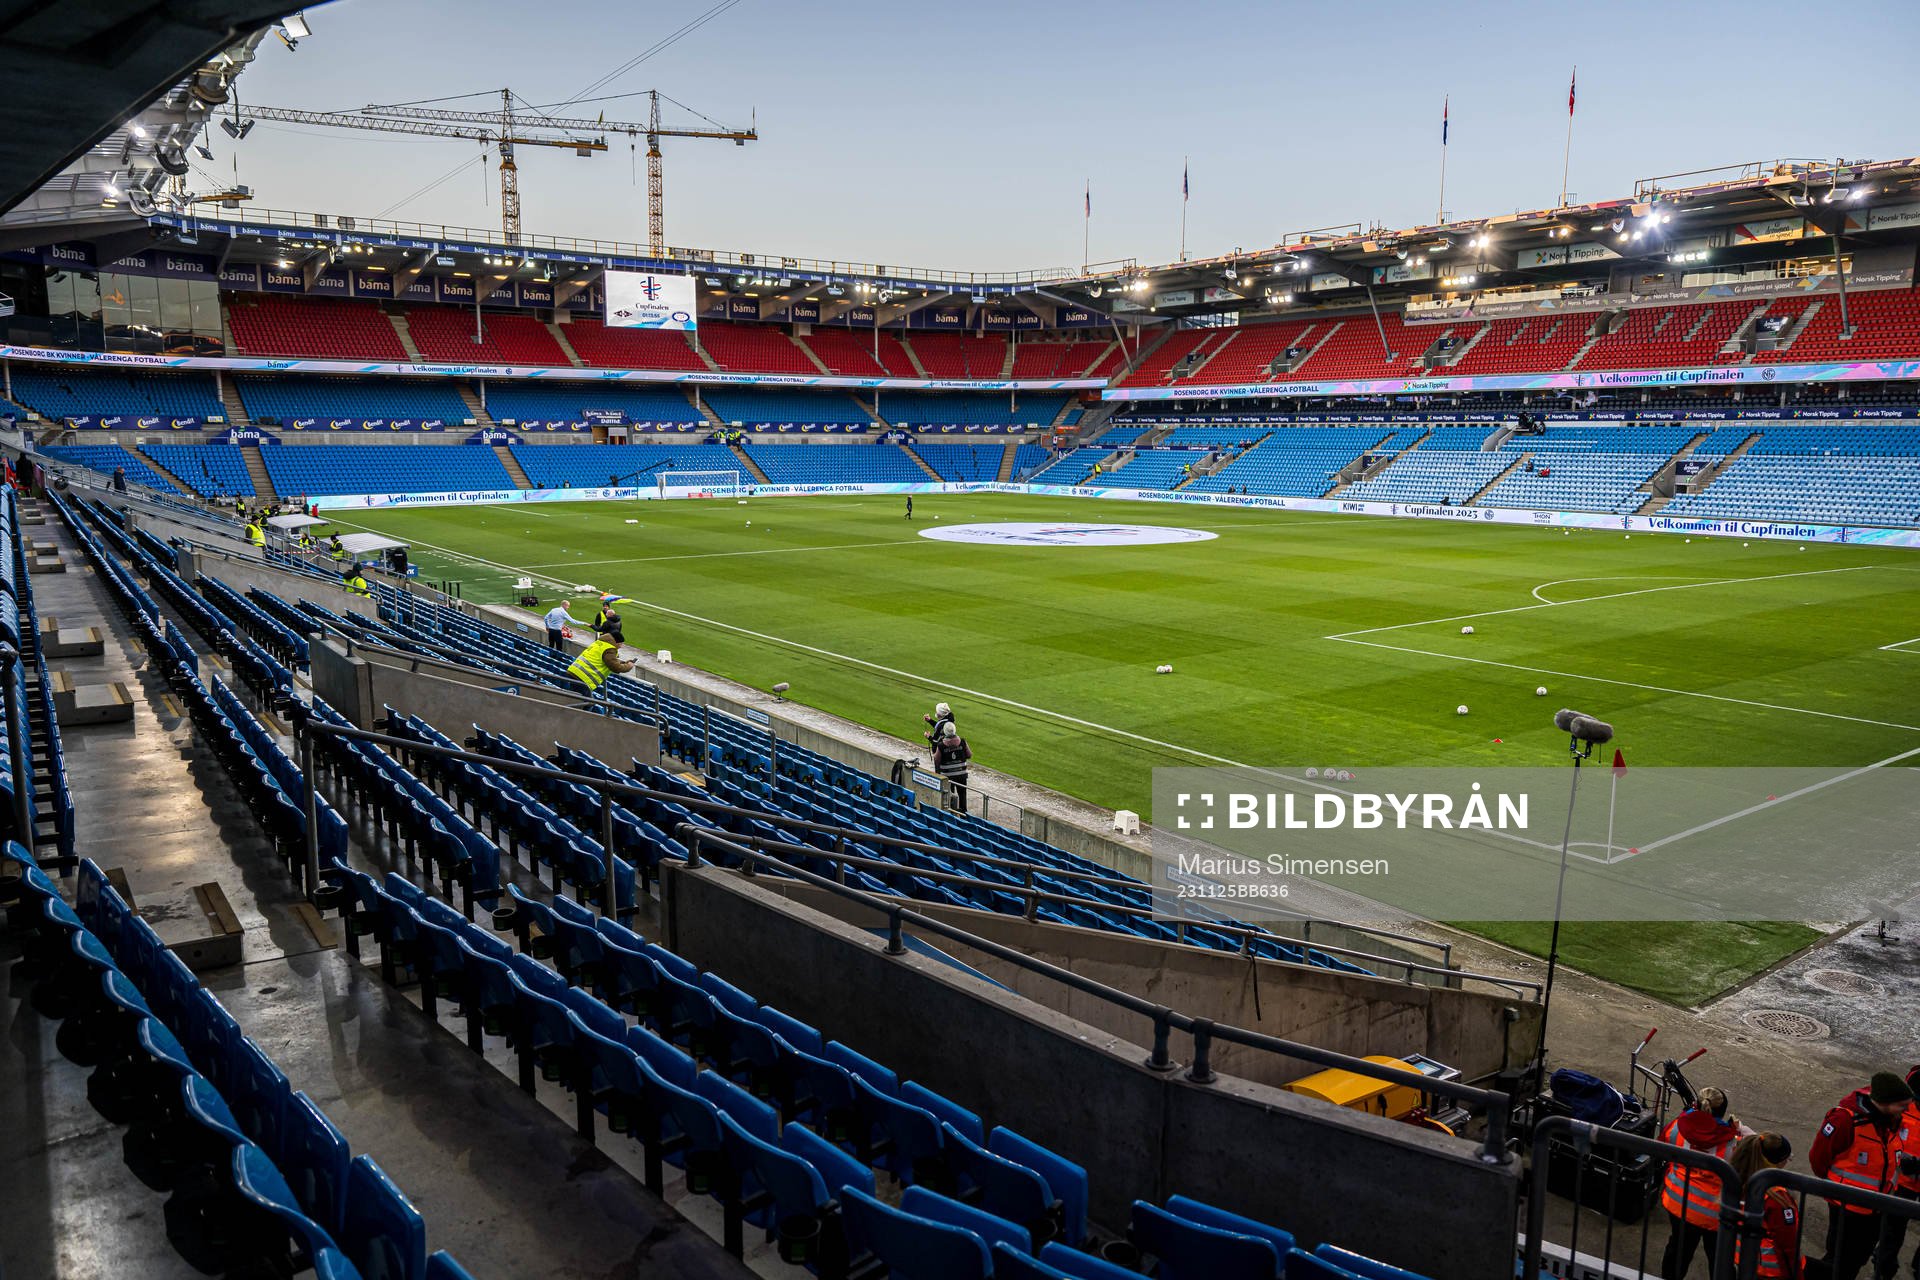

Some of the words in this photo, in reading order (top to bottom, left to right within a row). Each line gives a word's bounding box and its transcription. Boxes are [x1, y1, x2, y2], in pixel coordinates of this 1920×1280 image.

[1878, 214, 1898, 222] Norsk
[1574, 248, 1604, 260] Tipping
[1876, 274, 1901, 282] Tipping
[462, 366, 497, 375] Cupfinalen
[1600, 373, 1662, 384] Velkommen
[1666, 371, 1677, 382] til
[1680, 368, 1744, 384] Cupfinalen
[1220, 387, 1246, 395] KVINNER
[1250, 384, 1288, 394] VÅLERENGA
[1289, 385, 1319, 393] FOTBALL
[1429, 380, 1449, 390] Tipping
[1880, 410, 1902, 418] Tipping
[231, 429, 260, 438] bama
[483, 430, 507, 440] bama
[794, 484, 834, 492] VÅLERENGA
[388, 494, 444, 502] Velkommen
[448, 492, 457, 500] til
[460, 492, 509, 502] Cupfinalen
[1138, 492, 1174, 500] ROSENBORG
[1184, 494, 1211, 502] KVINNER
[1215, 496, 1254, 505] VÅLERENGA
[1254, 498, 1286, 506] FOTBALL
[1342, 502, 1358, 512] KIWI
[1404, 504, 1454, 516] Cupfinalen
[1649, 518, 1721, 532] Velkommen
[1724, 522, 1738, 533] til
[1741, 522, 1816, 538] Cupfinalen
